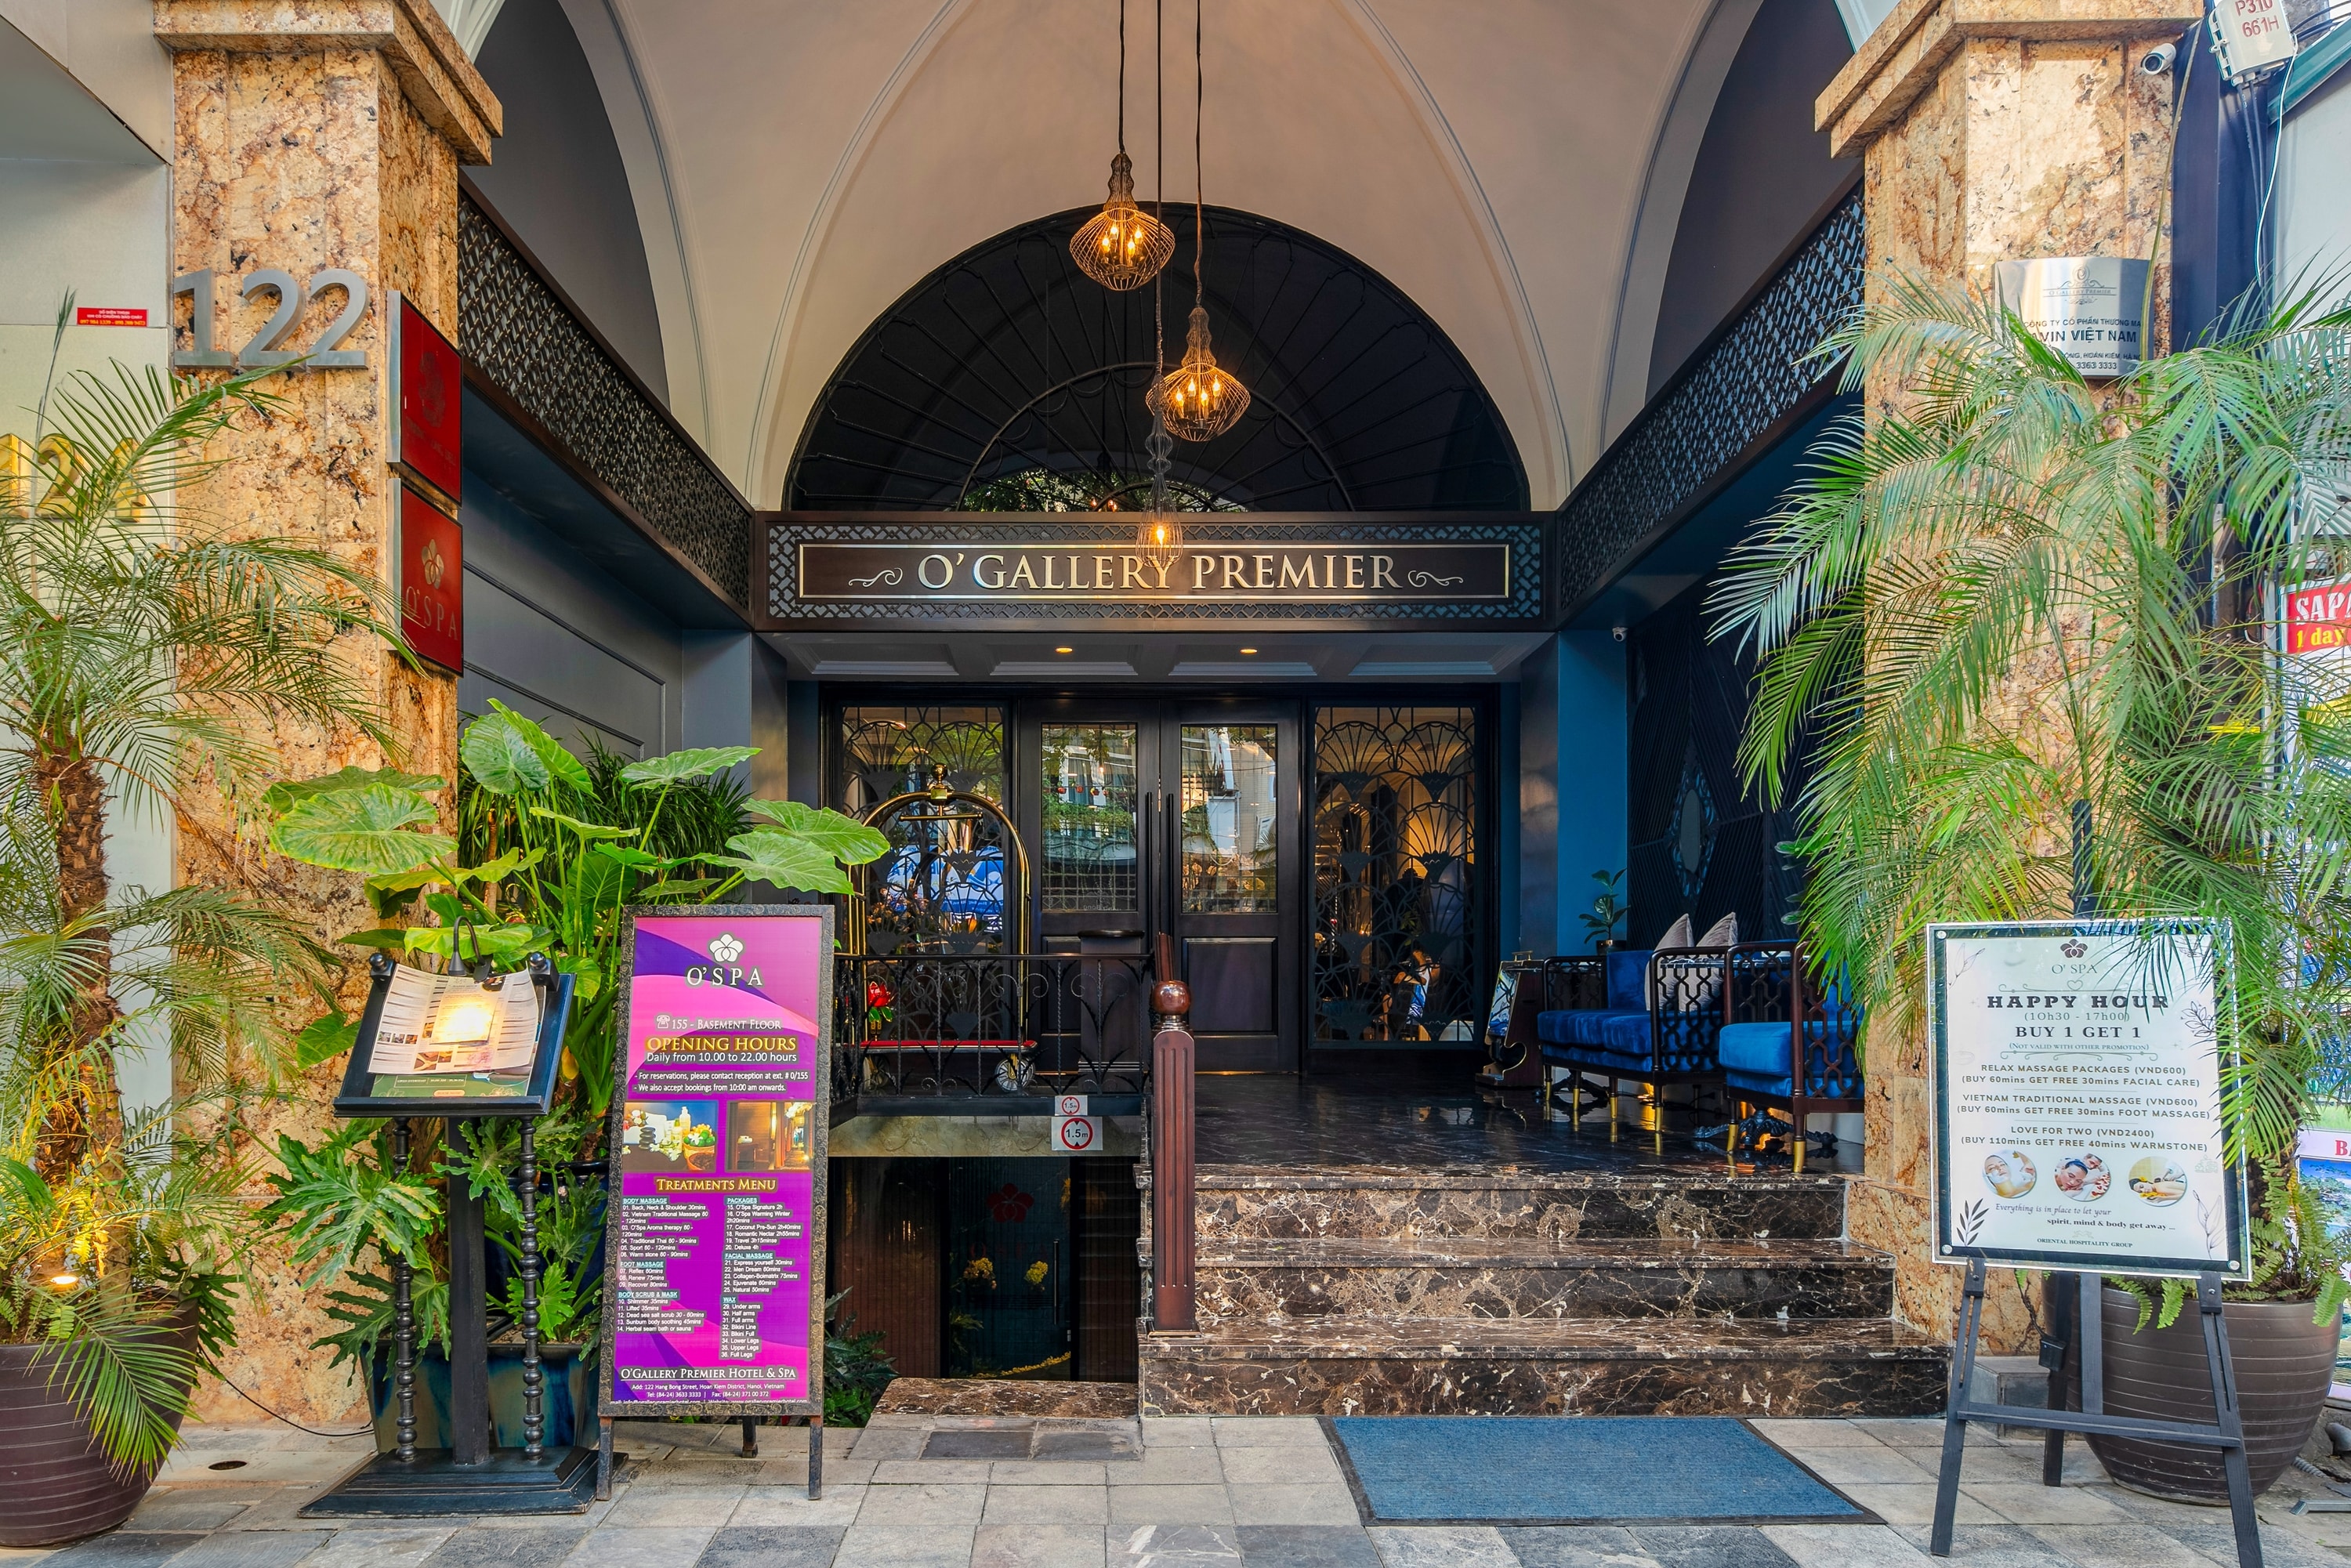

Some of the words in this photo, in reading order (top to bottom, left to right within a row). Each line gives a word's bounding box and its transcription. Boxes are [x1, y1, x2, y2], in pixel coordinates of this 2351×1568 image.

[2235, 0, 2273, 16] P310
[2242, 15, 2280, 38] 661H
[173, 268, 369, 372] 122
[2071, 327, 2104, 343] VIỆT
[2108, 330, 2136, 342] NAM
[918, 553, 1172, 591] O'GALLERY
[1193, 555, 1404, 591] PREMIER
[405, 585, 458, 641] O'SPA
[2297, 630, 2303, 648] 1
[2311, 627, 2346, 646] day
[2070, 965, 2098, 974] SPA
[687, 967, 763, 986] O'SPA
[1987, 996, 2077, 1009] HAPPY
[2091, 996, 2168, 1009] HOUR
[672, 1019, 687, 1029] 155
[2016, 1027, 2055, 1037] BUY
[2065, 1027, 2073, 1037] 1
[2083, 1027, 2122, 1037] GET
[2132, 1027, 2141, 1037] 1
[647, 1037, 730, 1051] OPENING
[734, 1037, 797, 1051] HOURS
[647, 1052, 670, 1063] Daily
[672, 1052, 696, 1062] from
[699, 1052, 725, 1062] 10.00
[741, 1052, 767, 1062] 22.00
[770, 1052, 797, 1062] hours
[650, 1072, 689, 1081] reservations,
[690, 1072, 709, 1081] please
[735, 1072, 763, 1081] reception
[785, 1072, 789, 1081] #
[791, 1072, 808, 1081] 0/155
[2135, 1066, 2186, 1076] (VND600)
[650, 1083, 662, 1092] also
[664, 1084, 683, 1093] accept
[685, 1083, 712, 1093] bookings
[758, 1083, 786, 1092] onwards.
[2167, 1078, 2200, 1088] CARE)
[2012, 1095, 2085, 1103] TRADITIONAL
[2146, 1098, 2197, 1107] (VND600)
[2152, 1110, 2210, 1120] MASSAGE)
[1066, 1129, 1089, 1138] 1.5m
[2097, 1128, 2154, 1139] (VND2400)
[2130, 1142, 2208, 1152] WARMSTONE)
[1996, 1203, 2034, 1215] Everything
[2052, 1206, 2071, 1215] place
[2093, 1209, 2111, 1218] your
[766, 1368, 775, 1378] &
